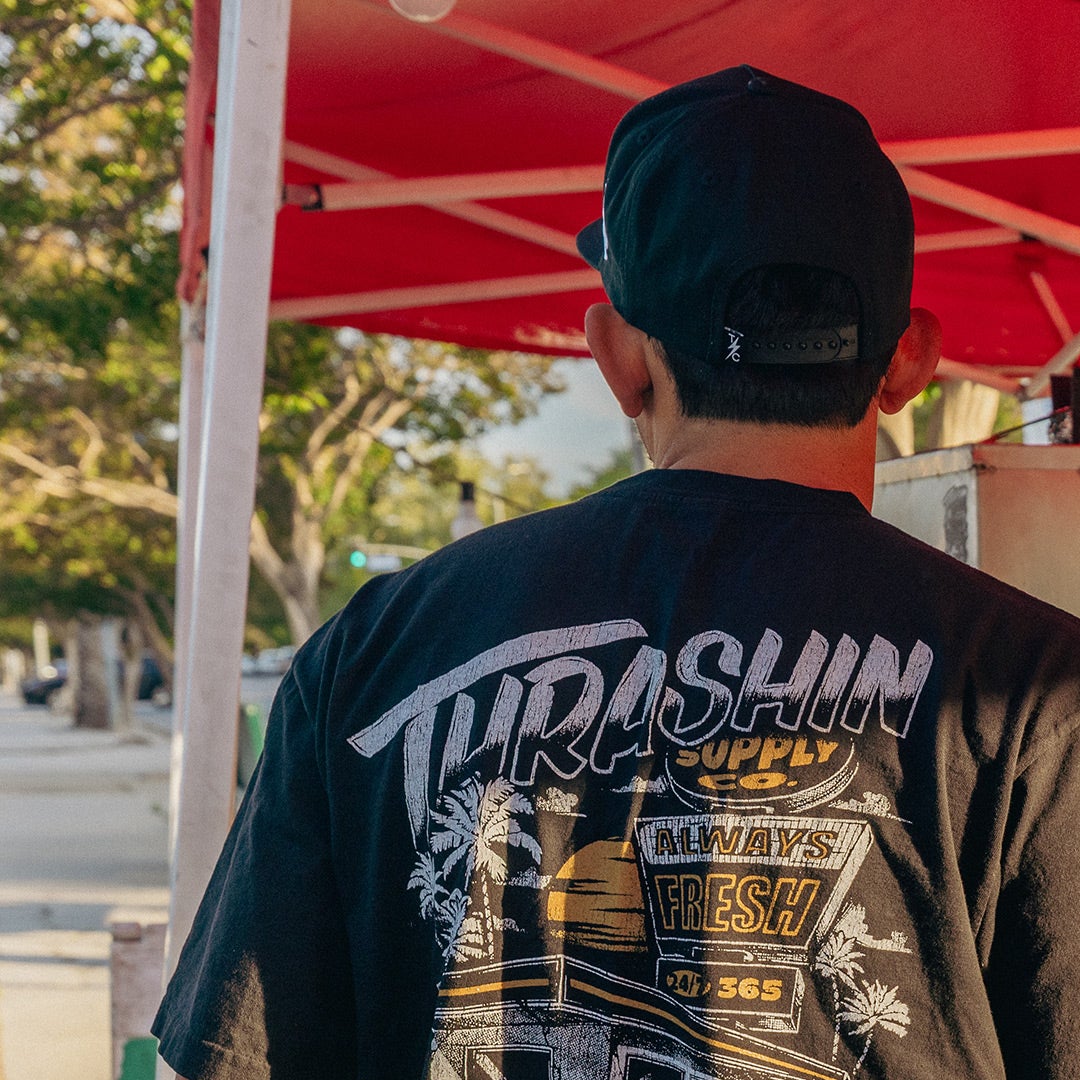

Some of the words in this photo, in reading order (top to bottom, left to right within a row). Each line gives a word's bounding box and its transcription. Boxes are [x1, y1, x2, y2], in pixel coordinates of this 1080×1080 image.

[347, 619, 934, 853] THRASHIN
[676, 735, 839, 771] SUPPLY
[697, 771, 798, 791] CO.
[656, 828, 840, 860] ALWAYS
[654, 873, 821, 936] FRESH
[717, 977, 783, 1000] 365
